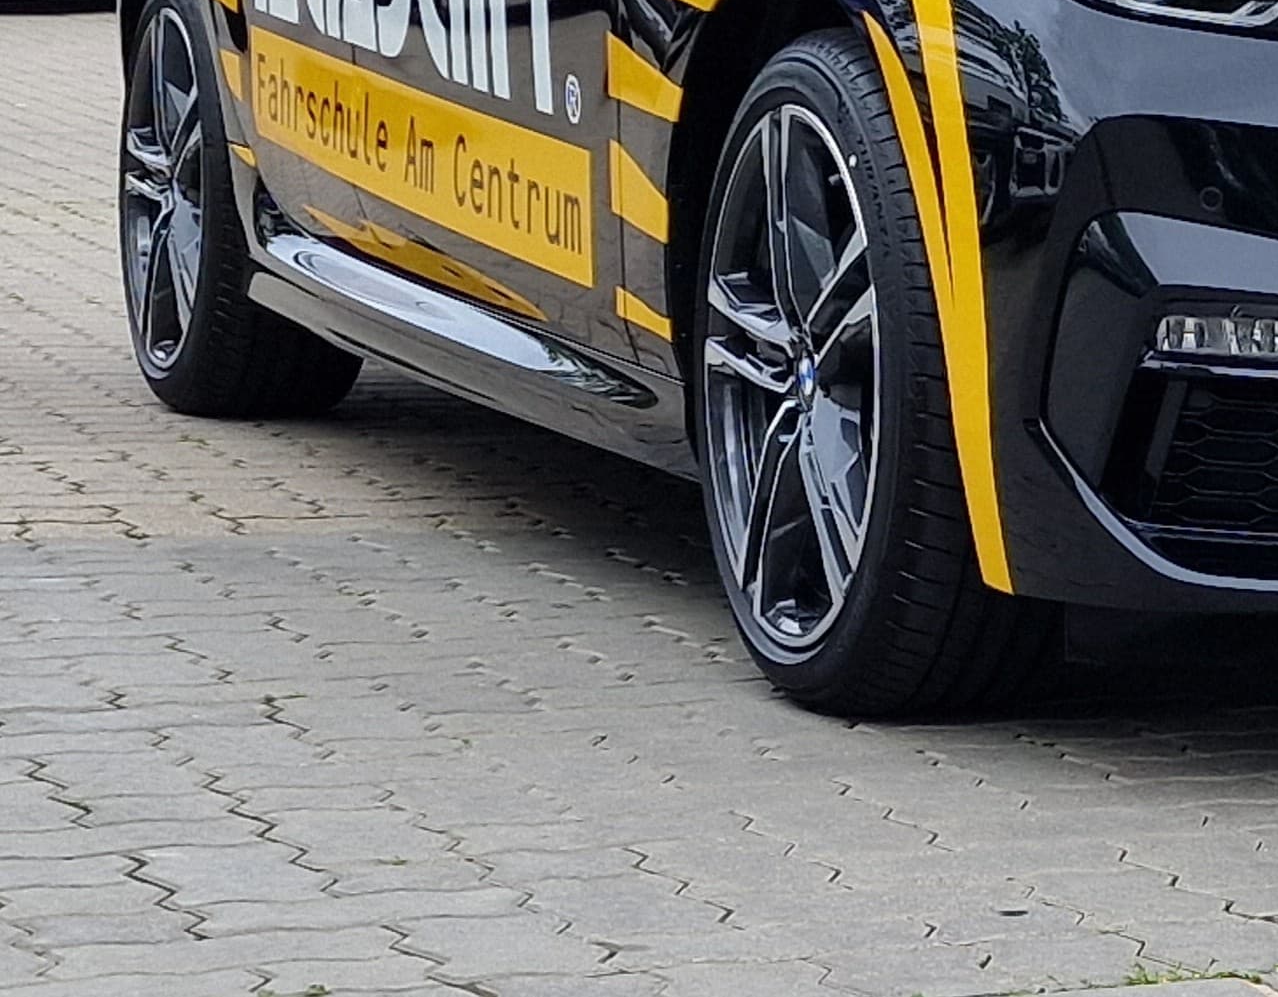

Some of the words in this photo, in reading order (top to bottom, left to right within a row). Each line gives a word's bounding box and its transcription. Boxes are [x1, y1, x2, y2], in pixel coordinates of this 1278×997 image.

[256, 53, 388, 173] Fahrschule
[404, 116, 436, 196] Am
[453, 135, 583, 255] Centrum
